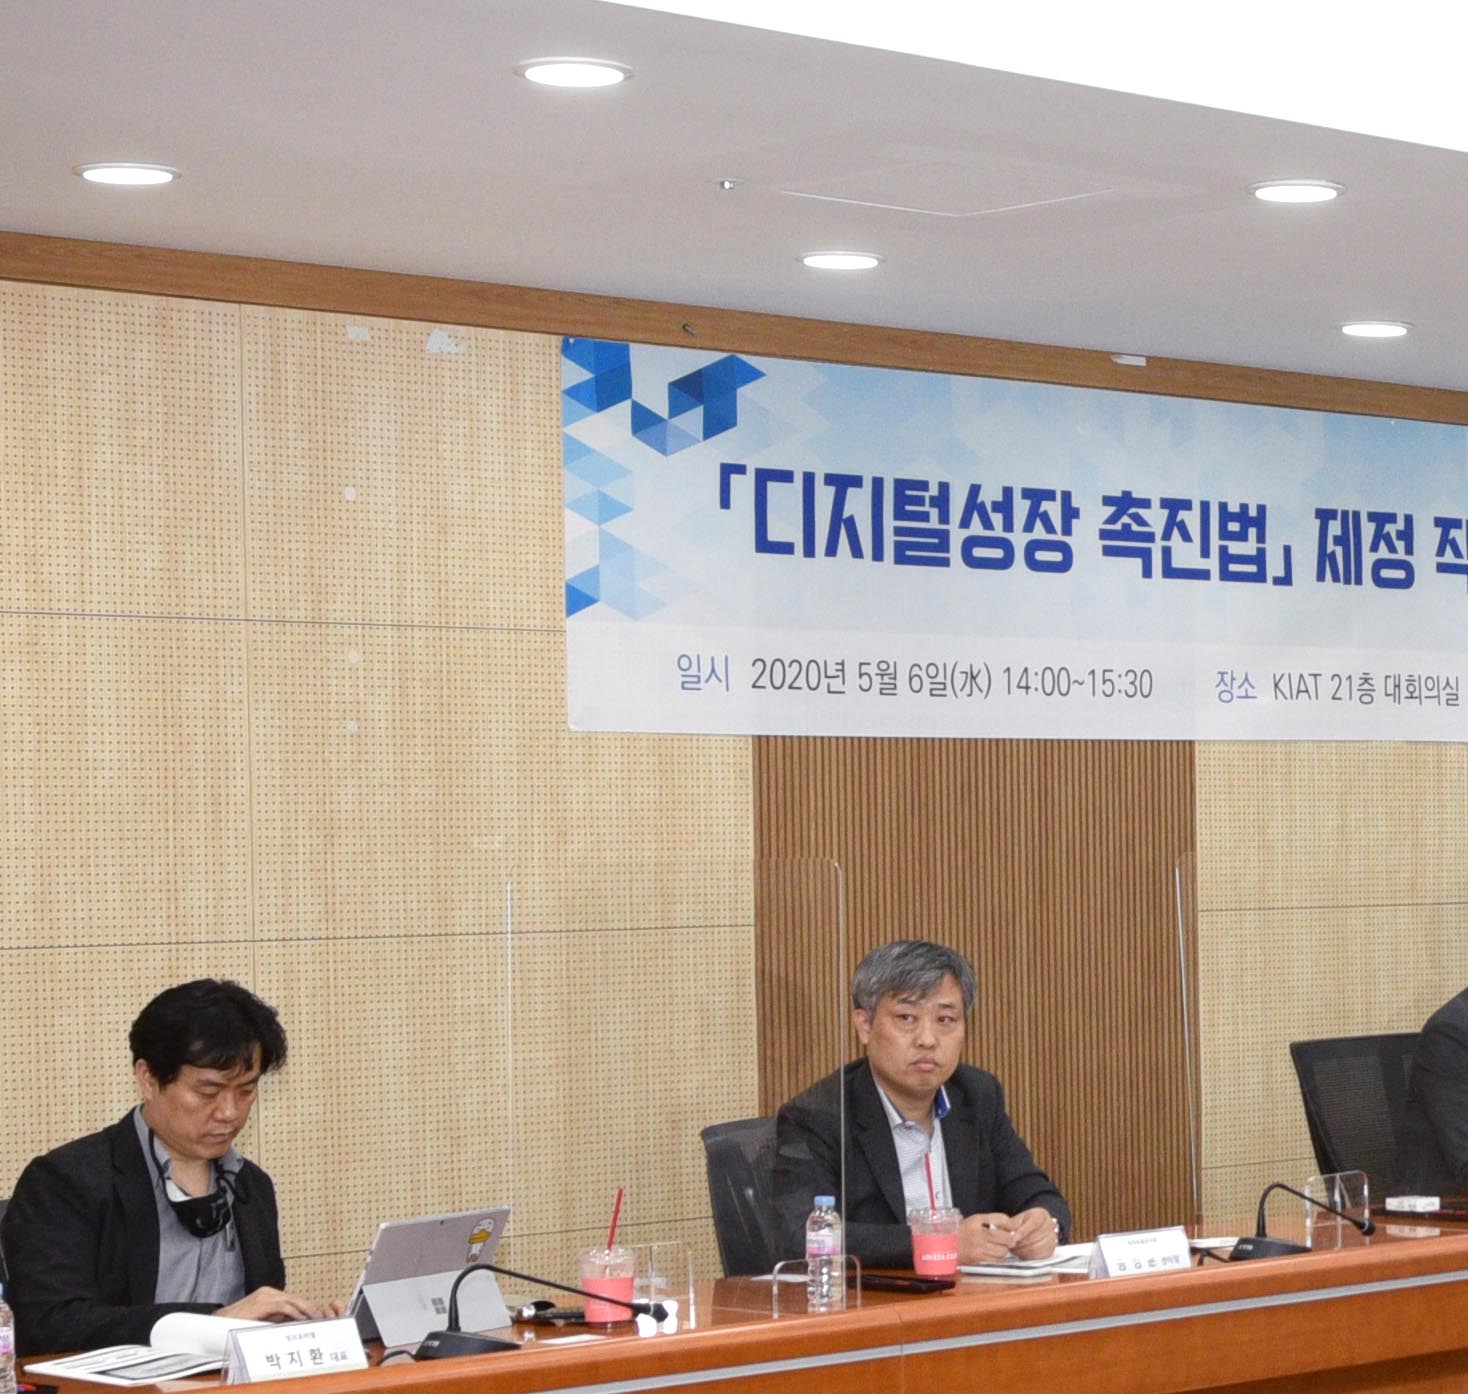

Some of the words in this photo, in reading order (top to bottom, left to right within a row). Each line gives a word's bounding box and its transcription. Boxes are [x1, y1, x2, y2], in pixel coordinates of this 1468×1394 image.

[720, 463, 1080, 573] 「디지털성장
[1099, 491, 1292, 586] 촉진법」
[1315, 508, 1414, 589] 제정
[677, 654, 729, 692] 일시
[752, 658, 845, 694] 2020년
[859, 660, 897, 696] 5월
[909, 662, 991, 699] 6일(水)
[1003, 667, 1152, 698] 14:00~15:30
[1216, 671, 1257, 703] 장소
[1273, 673, 1322, 700] KIAT
[1331, 672, 1376, 705] 21층
[1385, 674, 1459, 706] 대회의실
